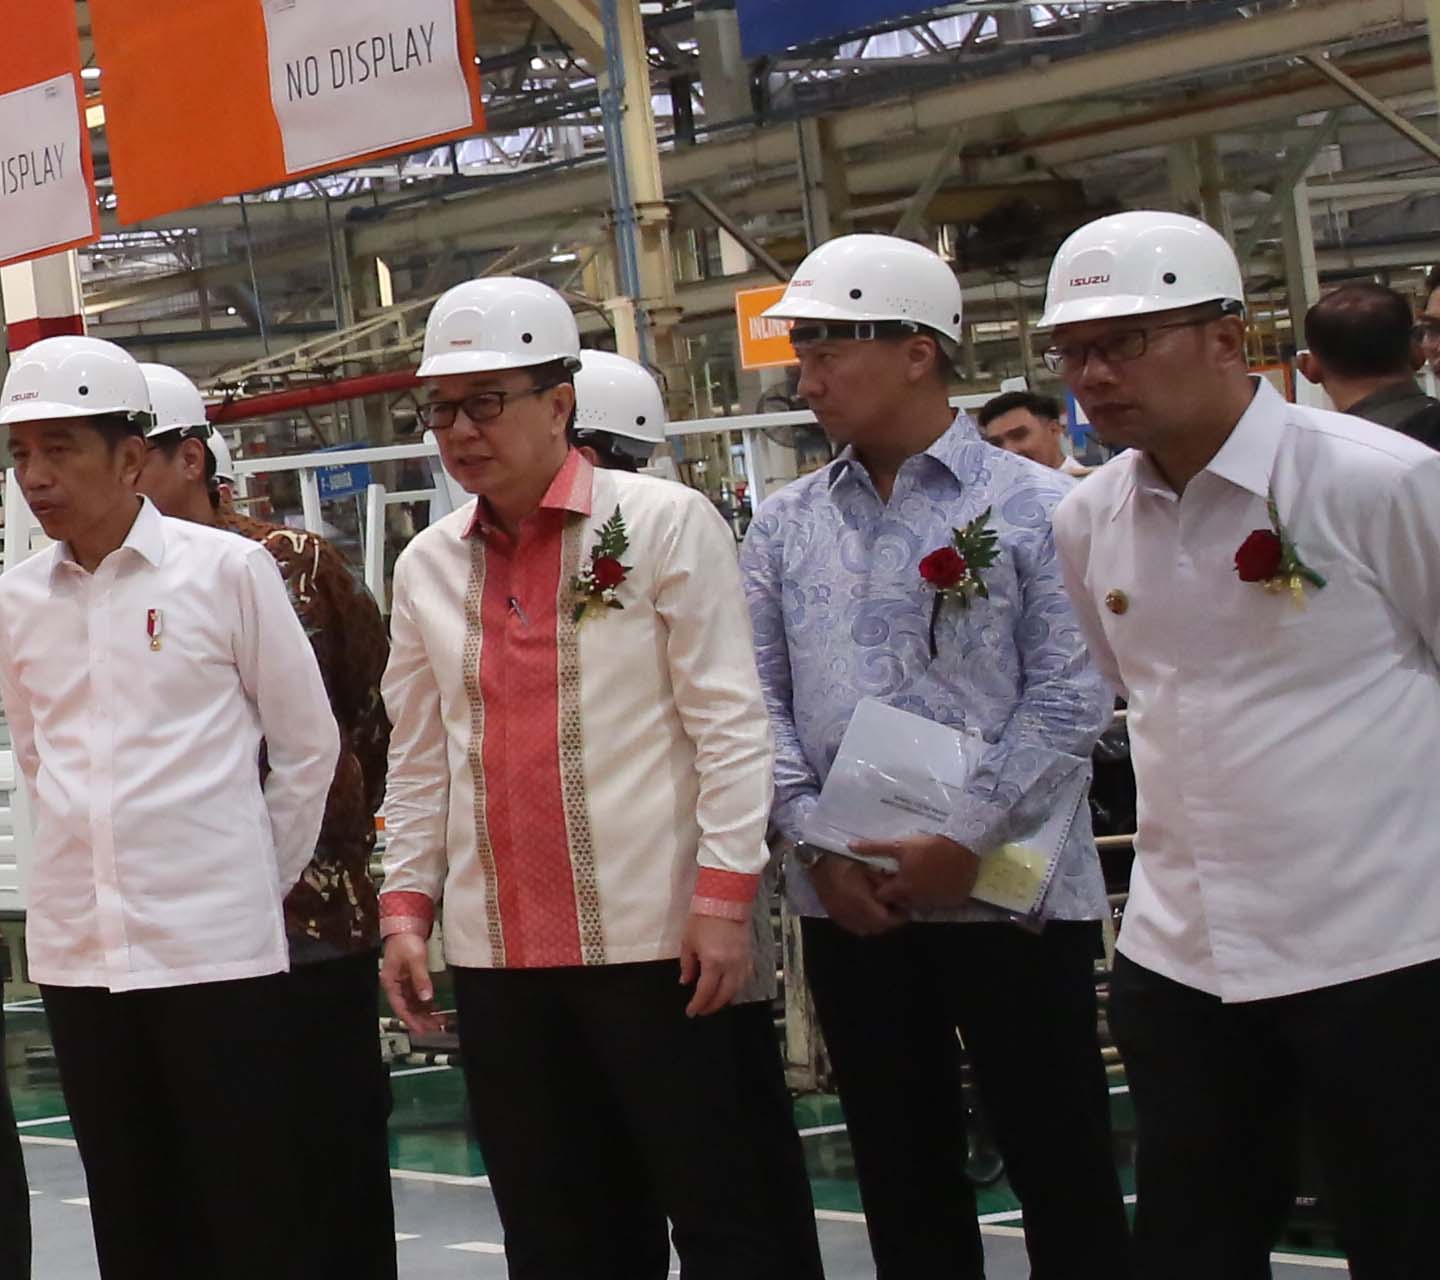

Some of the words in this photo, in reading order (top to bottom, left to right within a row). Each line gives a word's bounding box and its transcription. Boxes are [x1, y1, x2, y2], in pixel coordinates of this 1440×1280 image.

[286, 55, 320, 102] NO
[330, 21, 435, 90] DISPLAY
[1069, 274, 1110, 287] ISUZU
